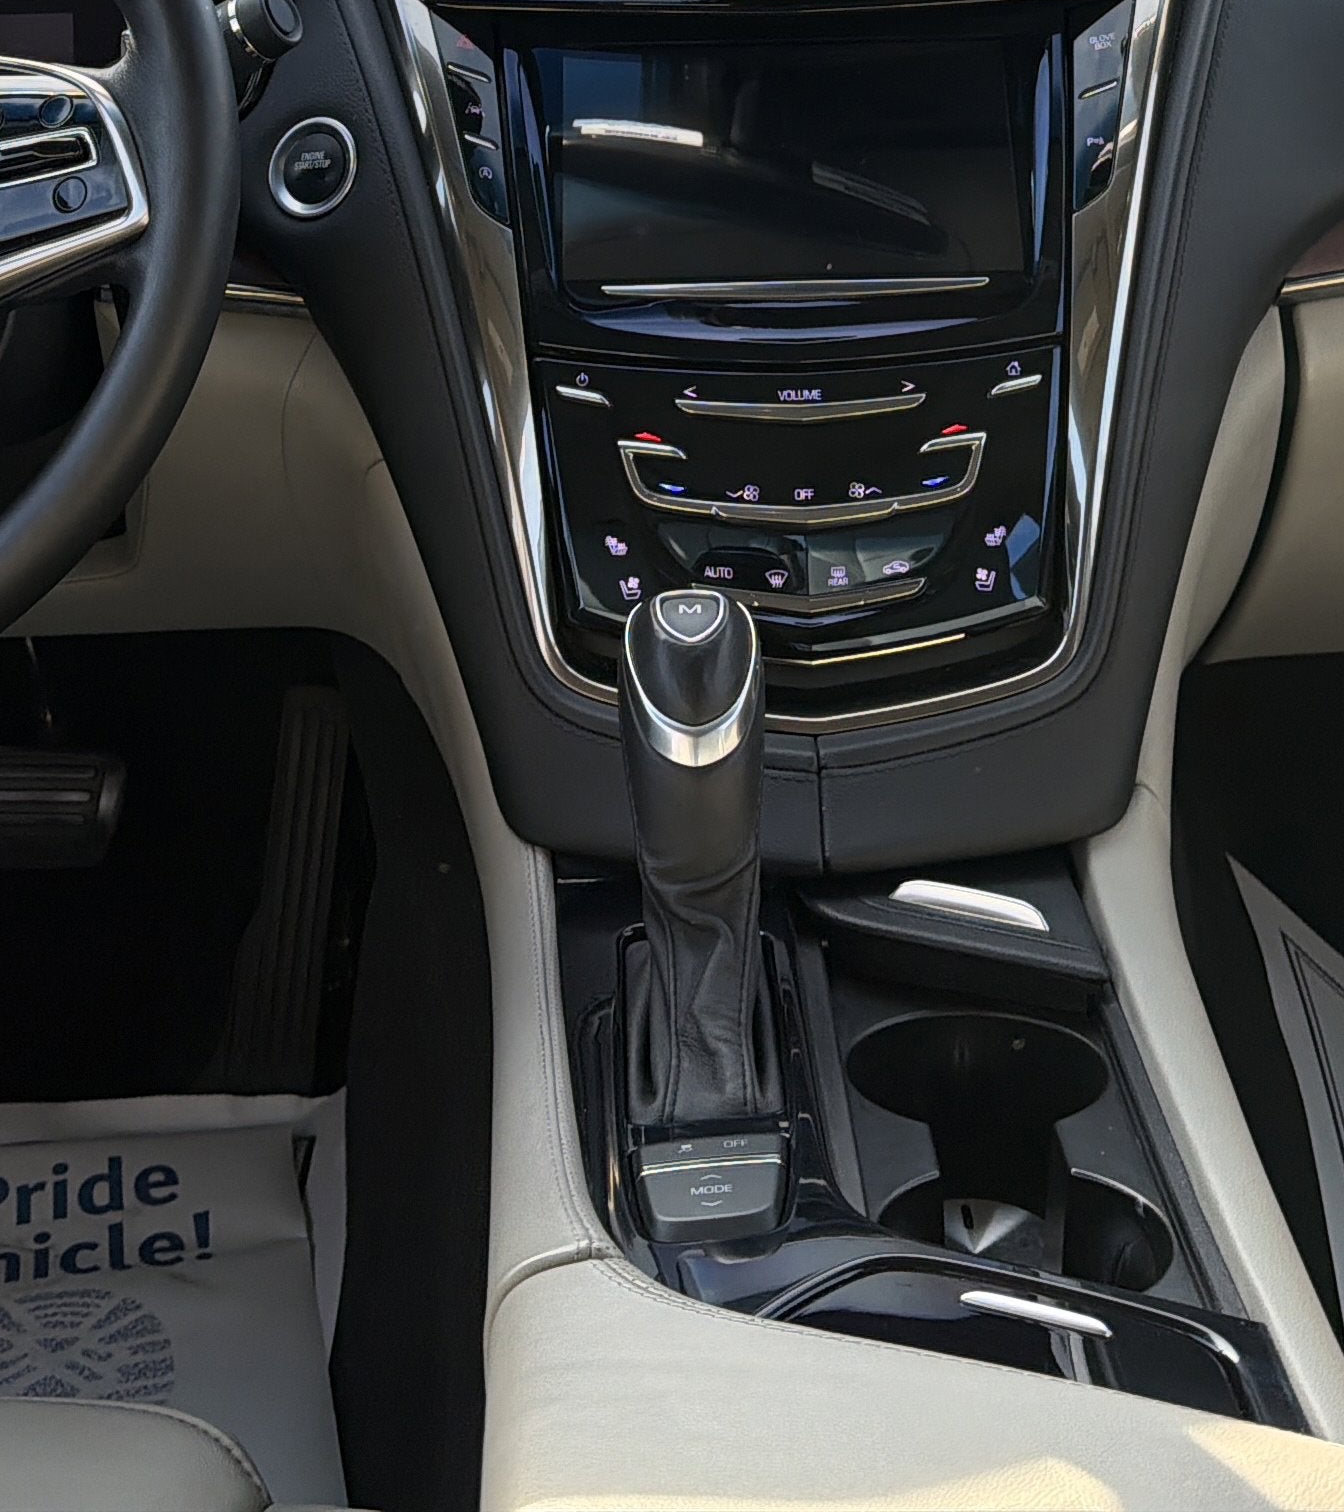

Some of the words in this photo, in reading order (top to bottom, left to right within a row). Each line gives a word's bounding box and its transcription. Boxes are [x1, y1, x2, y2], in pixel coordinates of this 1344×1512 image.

[1089, 32, 1115, 44] GLOVE
[1094, 41, 1112, 50] BOX
[300, 151, 325, 161] ENGINE
[294, 159, 332, 170] START/STOP
[777, 389, 822, 401] VOLUME
[794, 488, 815, 501] OFF
[704, 565, 733, 579] AUTO
[828, 577, 849, 586] REAR
[678, 603, 702, 615] M
[723, 1138, 748, 1148] OFF
[690, 1183, 733, 1196] MODE
